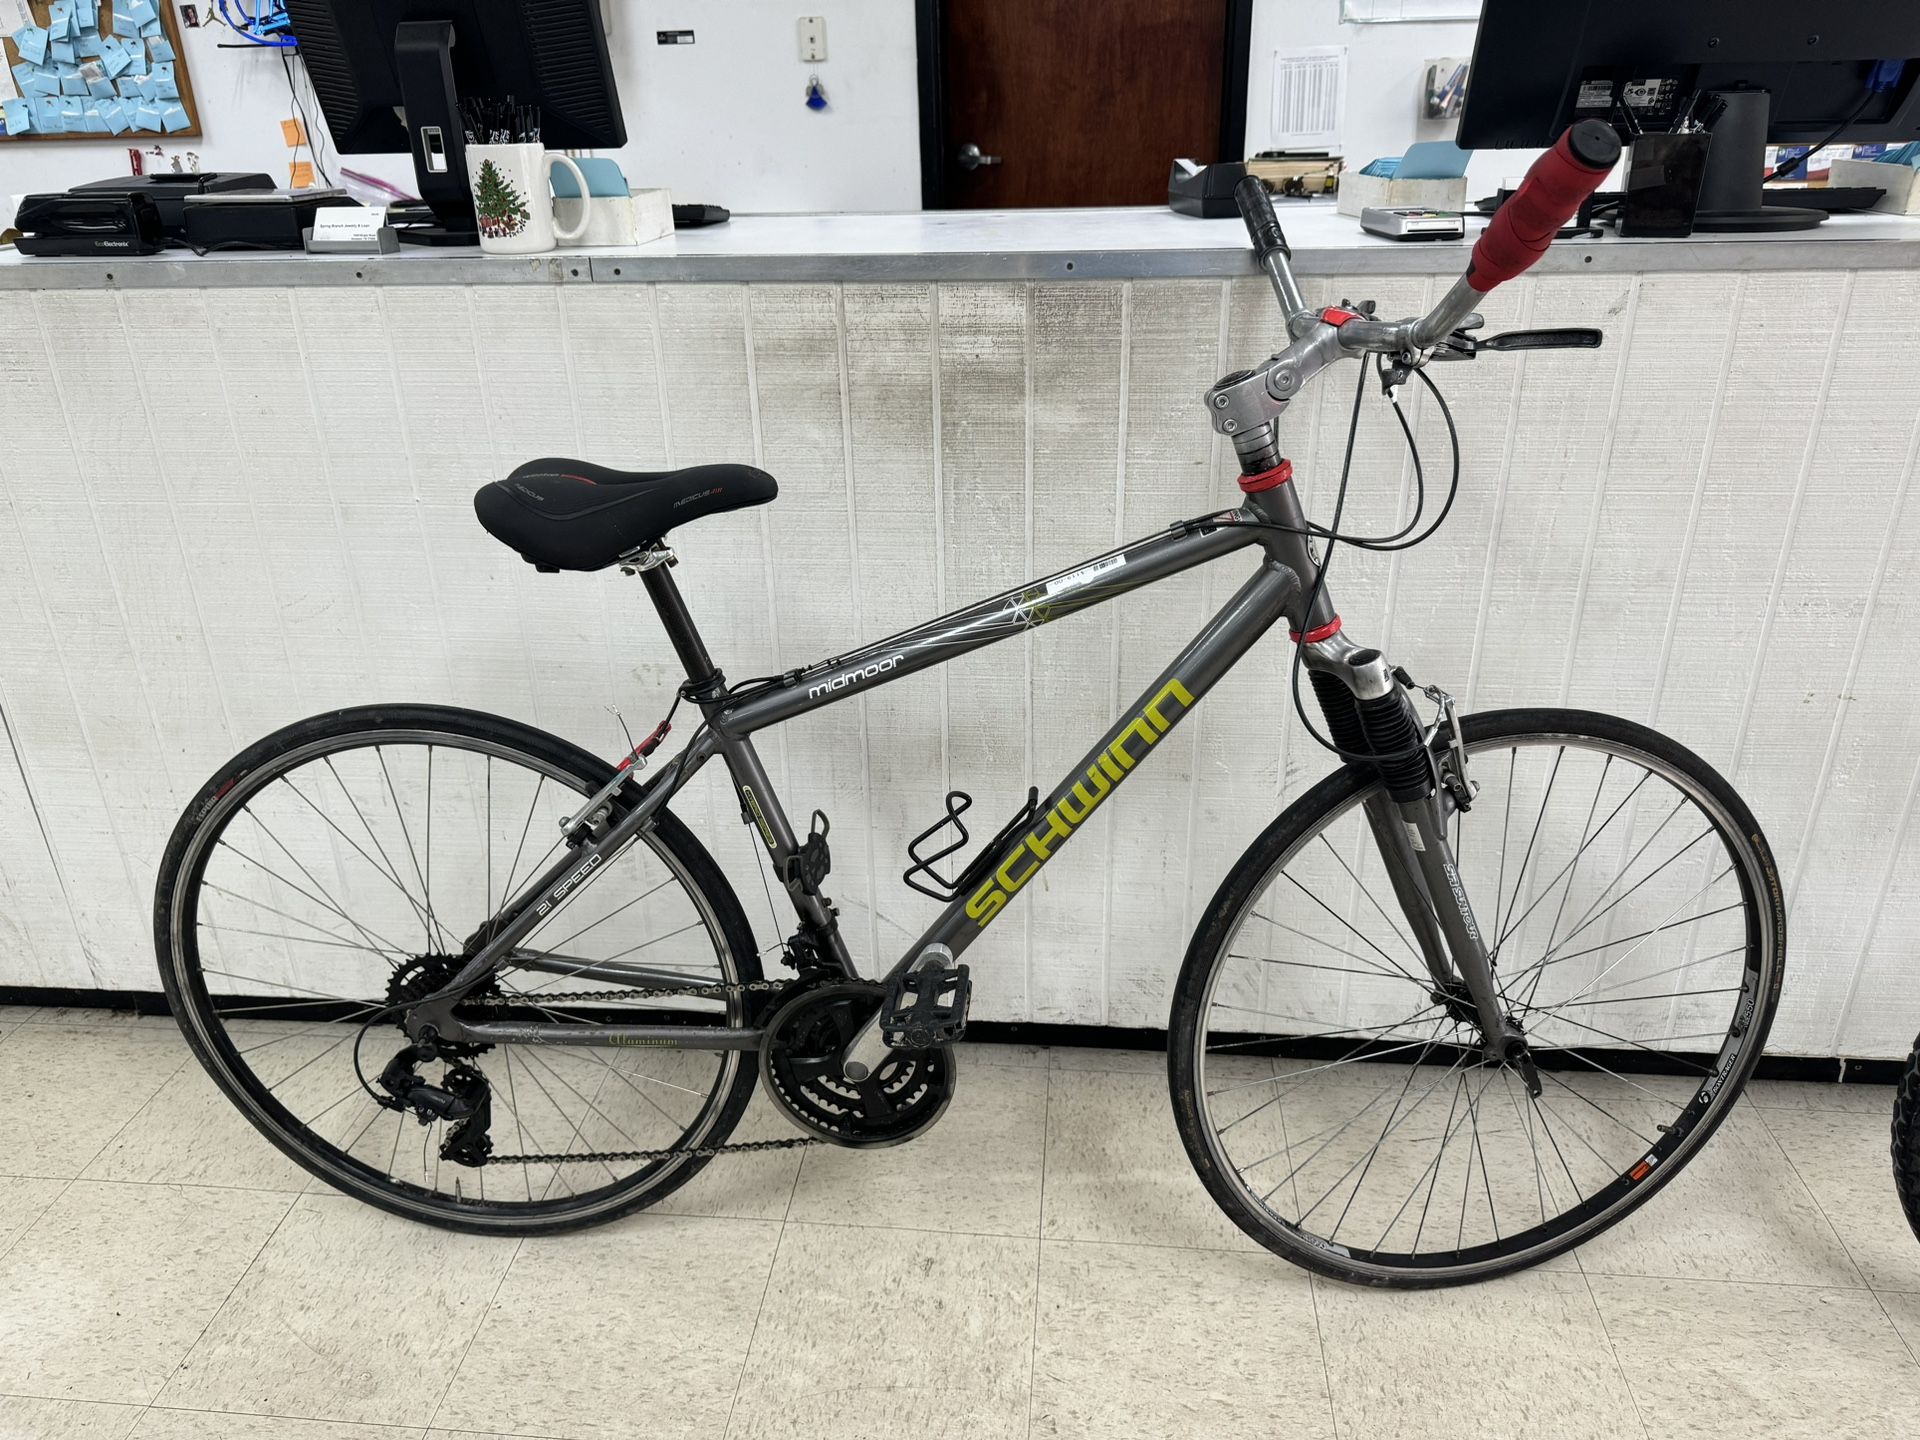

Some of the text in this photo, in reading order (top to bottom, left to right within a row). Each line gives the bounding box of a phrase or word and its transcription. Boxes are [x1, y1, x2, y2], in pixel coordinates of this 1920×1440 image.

[808, 654, 904, 699] midmoor
[965, 678, 1194, 927] SCHWINN
[536, 853, 602, 916] 21 SPEED
[1712, 1054, 1737, 1093] BONTRAGER
